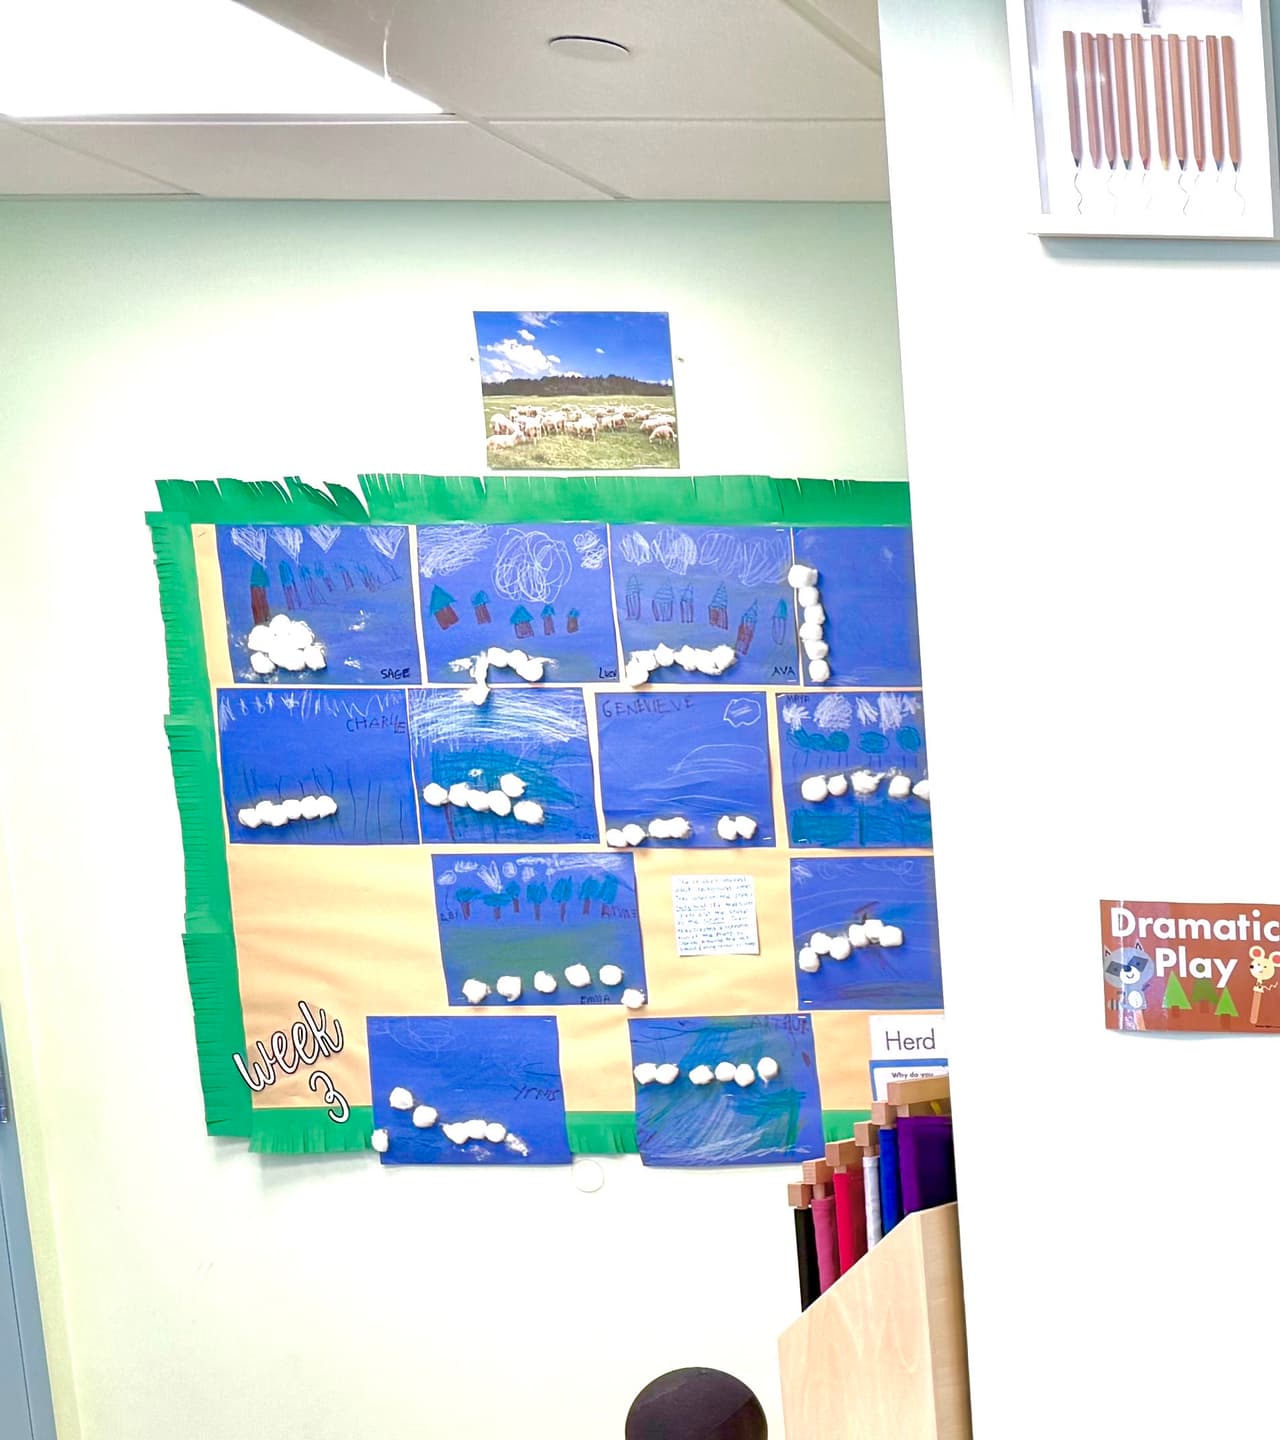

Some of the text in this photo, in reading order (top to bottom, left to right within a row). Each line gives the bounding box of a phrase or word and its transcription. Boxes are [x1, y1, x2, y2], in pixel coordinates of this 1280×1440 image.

[380, 667, 411, 680] SAGE
[771, 666, 796, 677] AVA
[1110, 907, 1280, 942] Dramatic
[1155, 945, 1240, 989] Play
[232, 1000, 344, 1093] week
[885, 1027, 936, 1051] Herd
[891, 1072, 908, 1080] Why
[308, 1070, 352, 1124] 3
